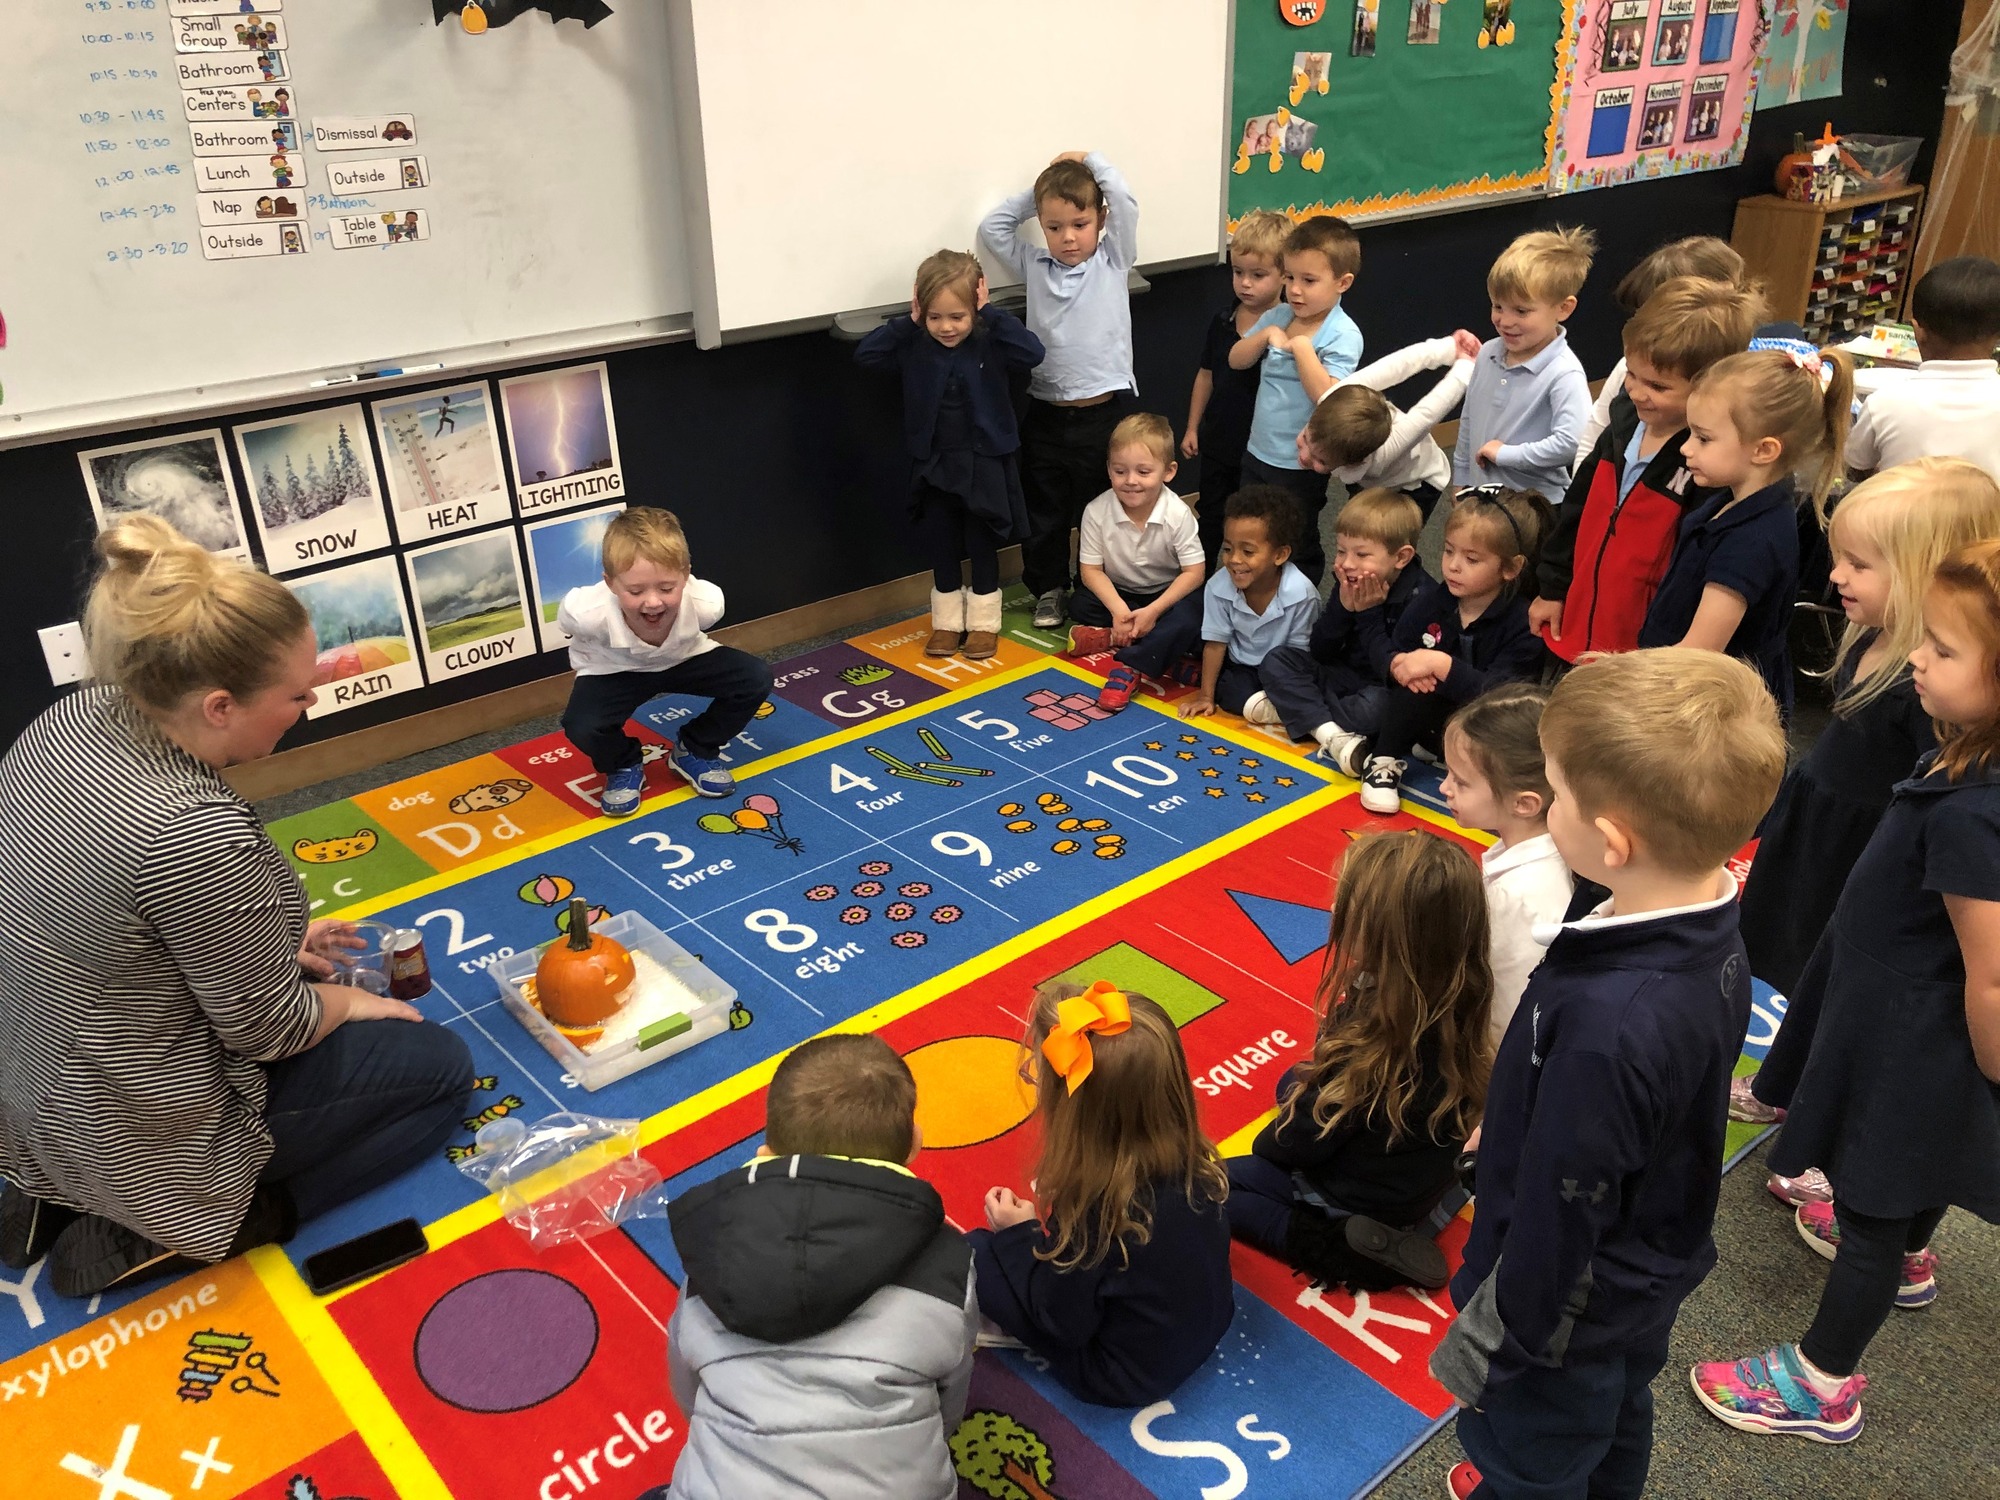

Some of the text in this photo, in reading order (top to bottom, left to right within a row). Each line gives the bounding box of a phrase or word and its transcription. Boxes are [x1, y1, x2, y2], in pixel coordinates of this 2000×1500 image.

[180, 16, 221, 31] Small
[180, 33, 227, 49] Group
[179, 64, 255, 80] Bathroom
[186, 96, 247, 111] Centers
[1599, 90, 1630, 105] October
[193, 132, 269, 147] Bathroom
[316, 125, 378, 141] Dismissal
[205, 165, 251, 180] Lunch
[334, 168, 386, 185] Outside
[213, 200, 242, 216] Nap
[340, 216, 377, 231] Table
[207, 234, 264, 249] Outside
[344, 232, 377, 245] Time
[427, 501, 480, 531] HEAT
[870, 628, 929, 651] house
[444, 636, 516, 671] CLOUDY
[773, 665, 820, 690] grass
[648, 704, 692, 726] fish
[956, 709, 1020, 743] 5
[527, 746, 574, 766] egg
[1007, 731, 1054, 757] five
[828, 763, 880, 798] 4
[1085, 753, 1179, 802] 10
[388, 788, 436, 813] dog
[856, 788, 905, 816] four
[1148, 792, 1188, 816] ten
[627, 830, 697, 870] 3
[930, 830, 994, 868] 9
[666, 855, 737, 892] three
[988, 857, 1041, 890] nine
[414, 908, 496, 957] 2
[742, 907, 819, 955] 8
[457, 946, 516, 975] two
[794, 938, 866, 981] eight
[1192, 1029, 1299, 1097] square
[0, 1280, 220, 1405] xylophone
[538, 1405, 675, 1500] circle
